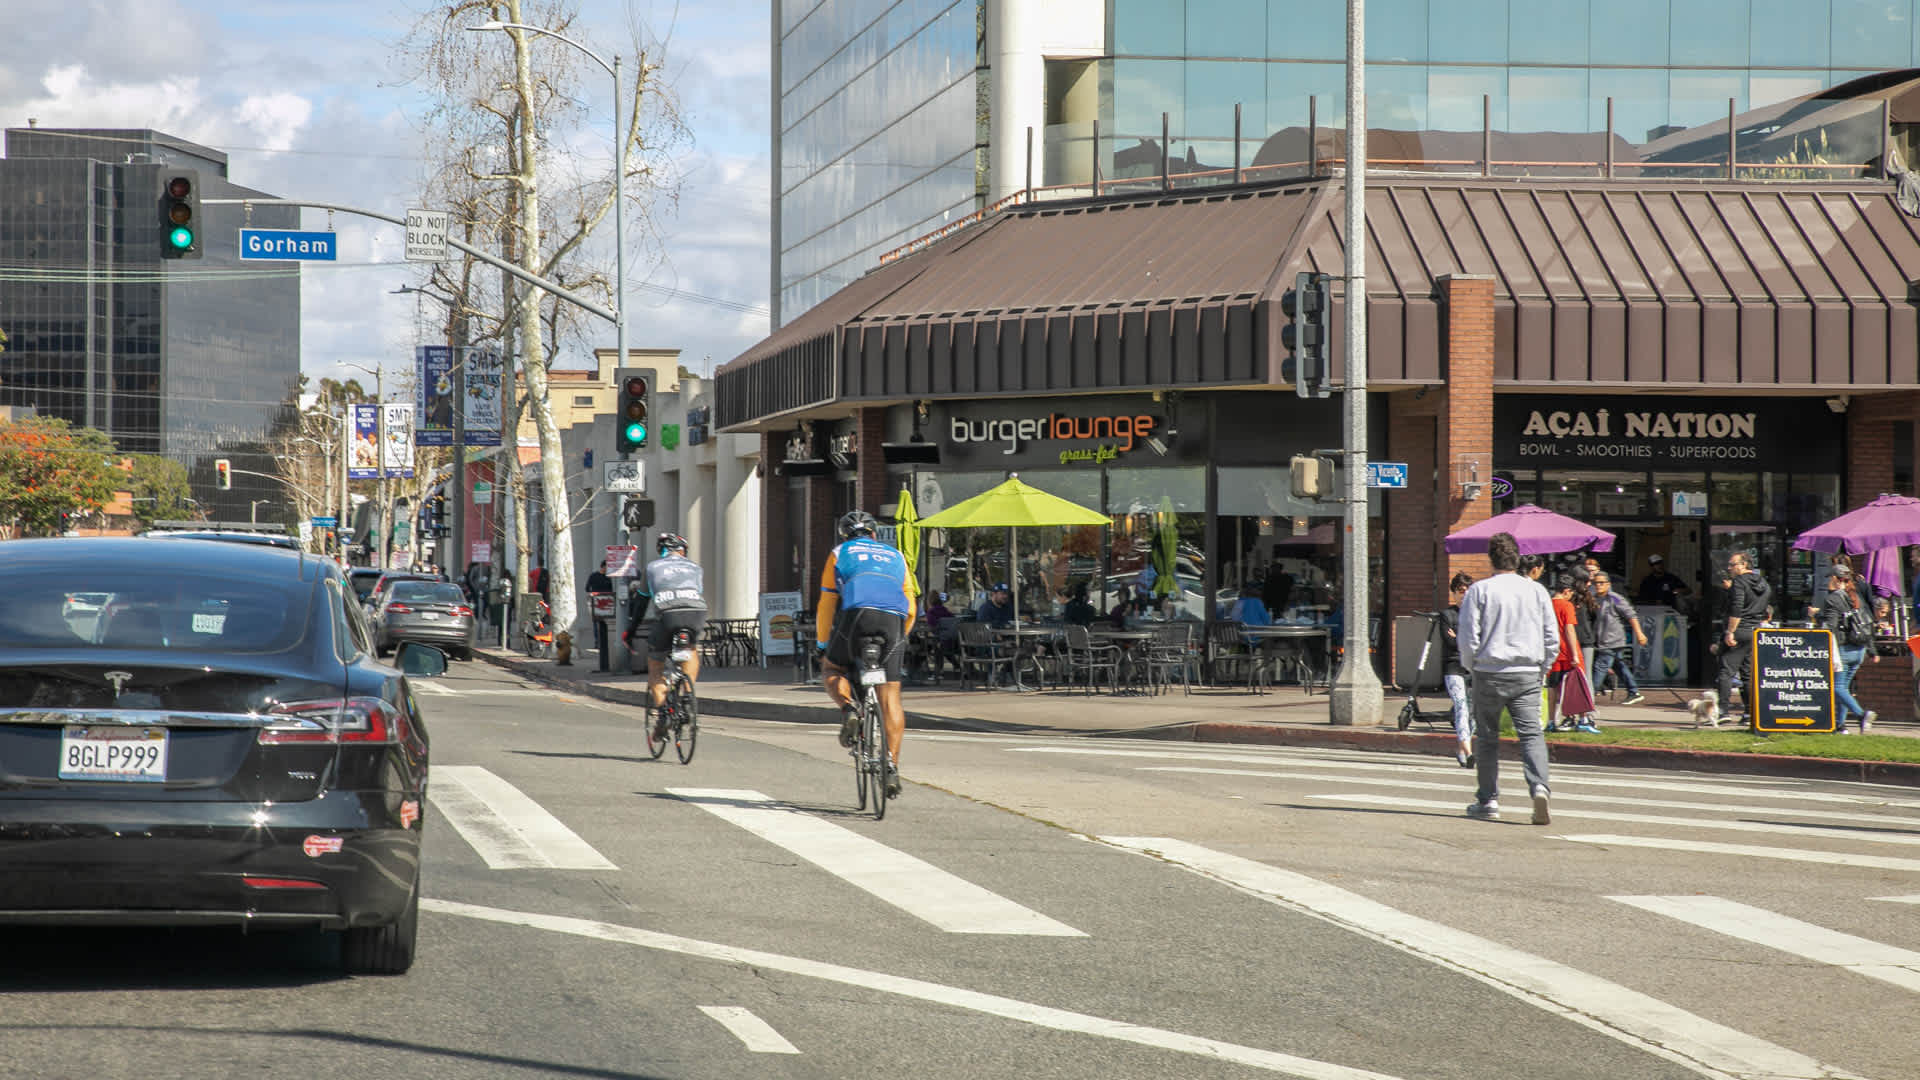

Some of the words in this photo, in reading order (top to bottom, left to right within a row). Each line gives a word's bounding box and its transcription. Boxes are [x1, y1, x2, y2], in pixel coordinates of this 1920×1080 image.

[408, 215, 422, 227] DO
[427, 216, 446, 229] NOT
[249, 235, 328, 254] Gorham
[408, 233, 446, 246] BLOCK
[1624, 412, 1756, 439] NATION
[951, 416, 1047, 455] burger
[1049, 413, 1154, 452] lounge
[1519, 443, 1560, 456] BOWL
[1576, 444, 1652, 457] SMOOTHIES
[1670, 446, 1757, 459] SUPERFOODS
[1676, 494, 1686, 505] A
[1758, 632, 1803, 649] Jacques
[1781, 646, 1829, 659] Jewelers
[1763, 667, 1792, 678] Expert
[1760, 680, 1795, 691] Jewelry
[1796, 680, 1804, 689] &
[1804, 680, 1829, 690] Clock
[1778, 691, 1813, 703] Repairs
[68, 745, 159, 769] 8GLP999
